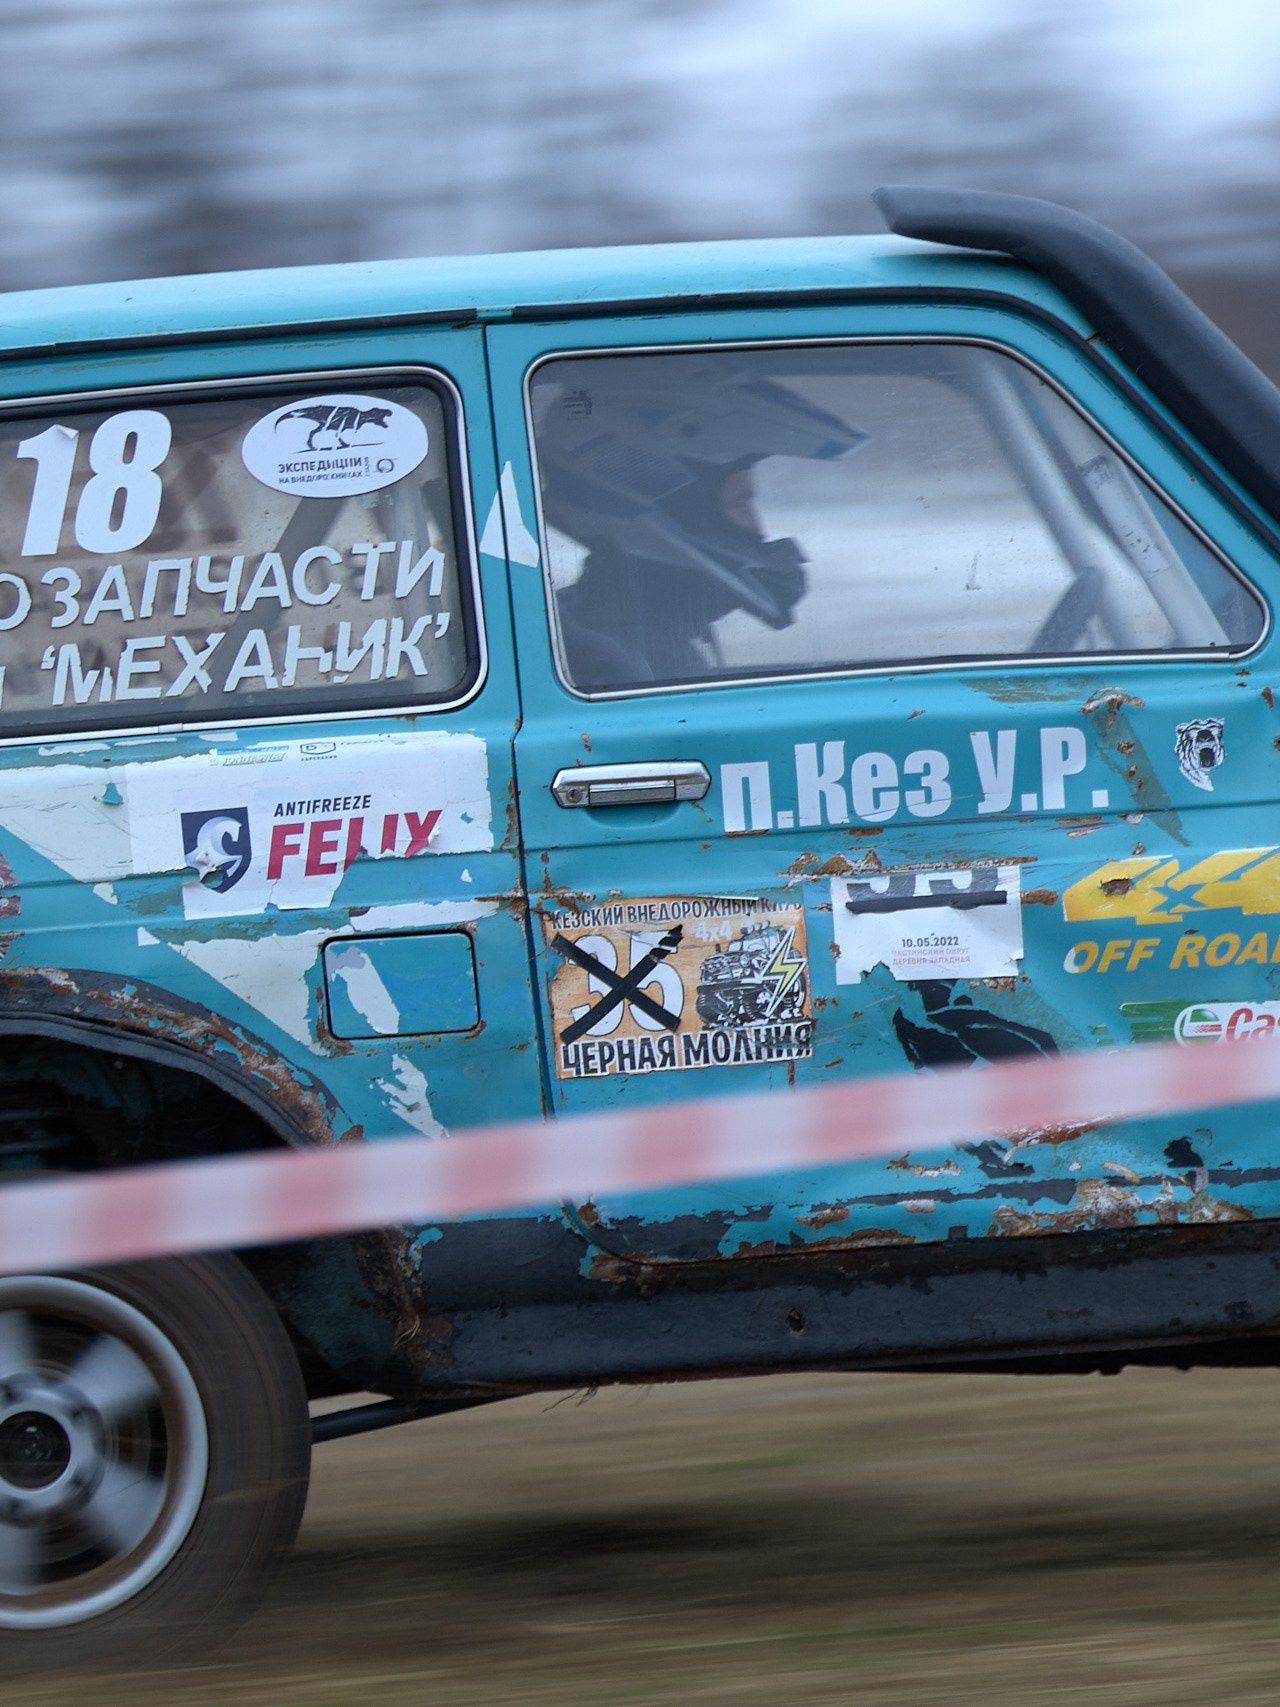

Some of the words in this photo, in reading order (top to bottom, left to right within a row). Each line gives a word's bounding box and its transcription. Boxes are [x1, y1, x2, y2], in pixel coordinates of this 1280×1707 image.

[278, 457, 362, 474] ЭКСПЕДИЦИИ
[16, 409, 173, 557] 18
[970, 726, 1110, 815] У.Р.
[274, 794, 372, 817] ANTIFREEZE
[551, 903, 624, 931] КЕЗСКИЙ
[627, 898, 758, 924] ВНЕДОРОЖНЫЙ
[902, 936, 960, 948] 10.05.2022
[1063, 938, 1161, 974] OFF
[561, 1034, 675, 1076] ЧЕРНАЯ
[683, 1023, 813, 1067] МОЛНИЯ
